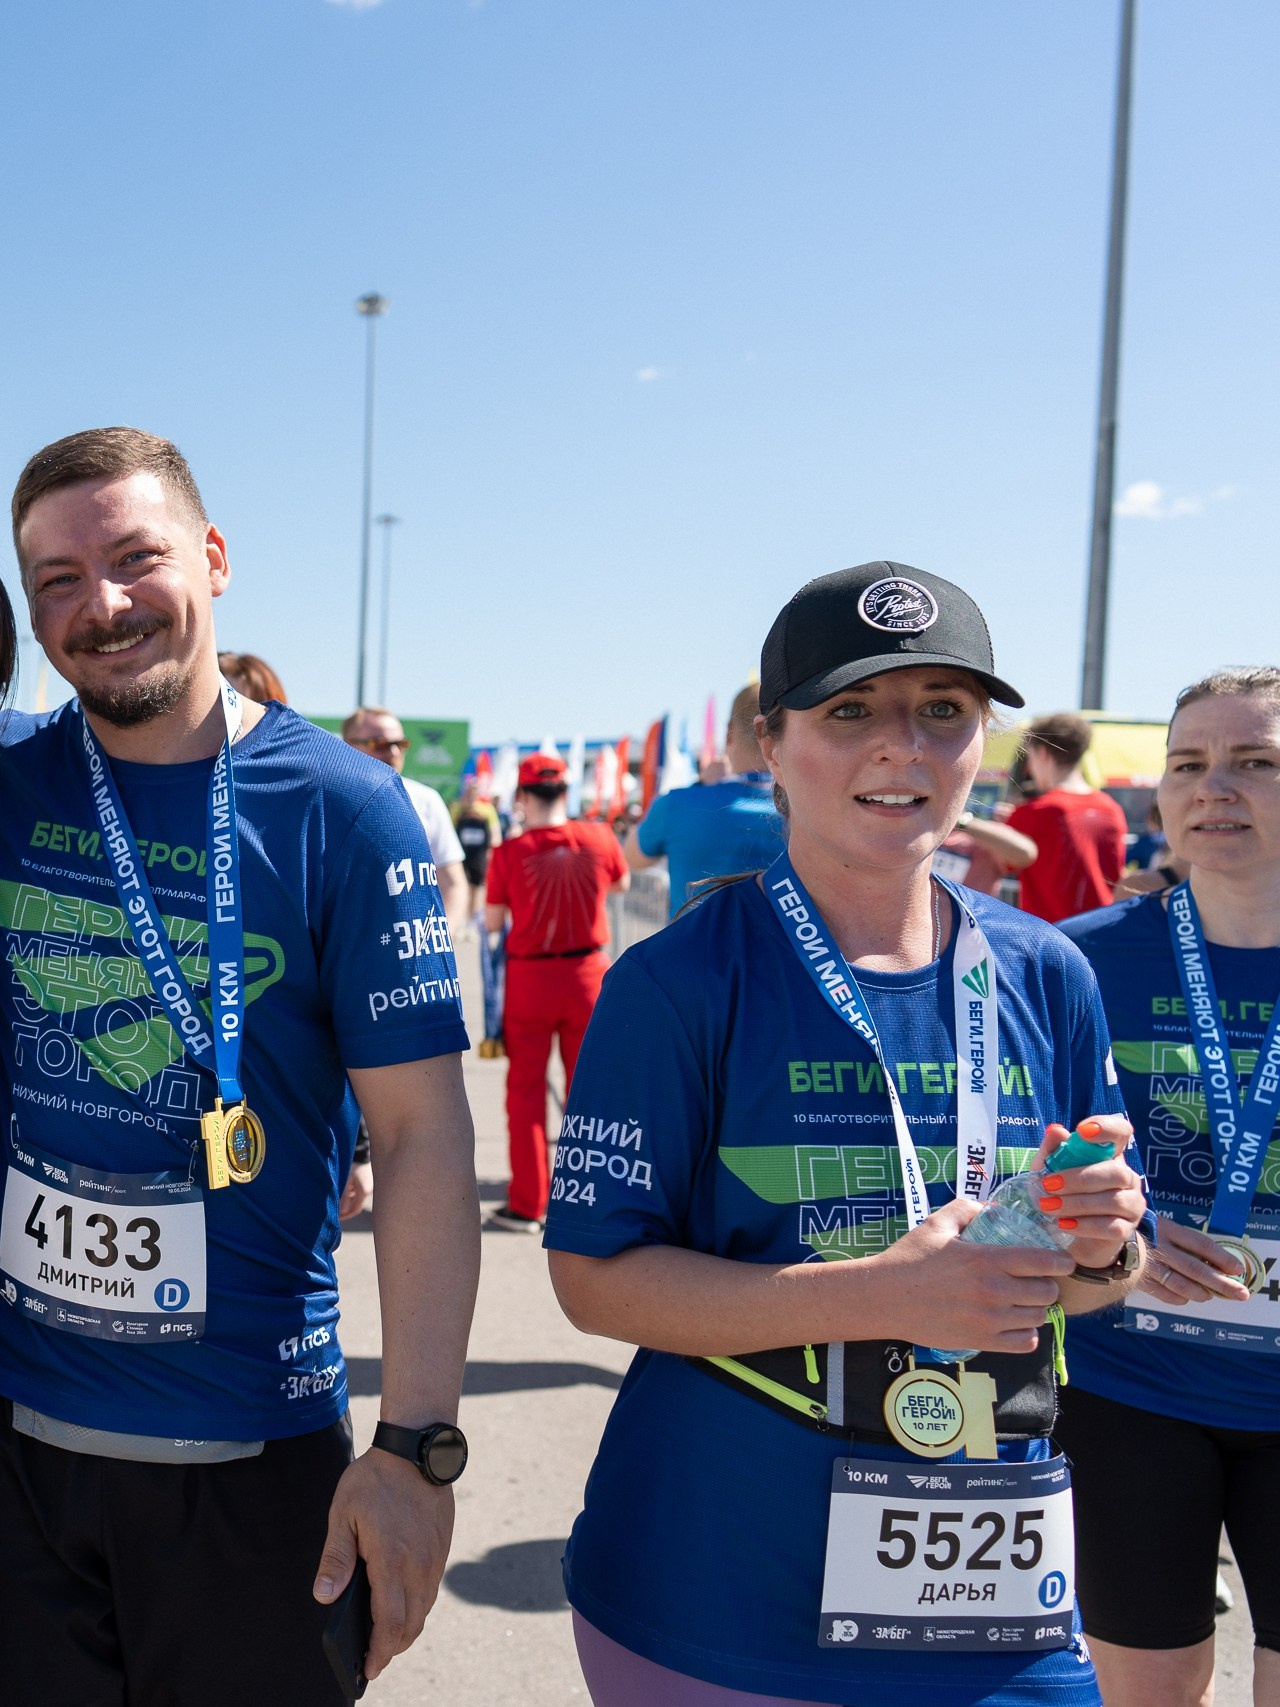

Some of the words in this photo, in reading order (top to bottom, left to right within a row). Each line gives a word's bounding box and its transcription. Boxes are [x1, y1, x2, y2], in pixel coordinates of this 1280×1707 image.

[21, 858, 31, 868] 10
[31, 863, 117, 888] БЛАГОТВОРИТЕЛЬ
[214, 833, 237, 923] ГЕРОИ
[94, 786, 141, 892] МЕНЯЮТ
[128, 895, 166, 961] ЭТОТ
[153, 965, 213, 1056] ГОРОД
[772, 878, 828, 960] ГЕРОИ
[1173, 888, 1199, 950] ГЕРОИ
[1183, 953, 1220, 1042] МЕНЯЮТ
[221, 1012, 239, 1043] 10
[969, 1001, 983, 1038] БЕГИ,
[896, 1057, 1034, 1097] ГЕРЙ!
[971, 1041, 987, 1094] ГЕРОЙ!
[1204, 1045, 1233, 1104] ЭТОТ
[12, 1083, 67, 1110] НИЖНИЙ
[71, 1101, 169, 1134] НОВГОРОД
[793, 1114, 806, 1123] 10
[809, 1113, 947, 1124] БЛАГОТВОРИТЛЬНЫЙ
[17, 1150, 24, 1161] 10
[551, 1177, 596, 1206] 2024
[1227, 1171, 1250, 1193] 10
[24, 1194, 161, 1271] 4133
[37, 1260, 135, 1299] ДМИТРИЙ
[163, 1283, 182, 1307] D
[173, 1323, 192, 1332] ПСБ
[301, 1326, 331, 1351] ПСБ
[902, 1406, 956, 1420] ГЕРОЙ!
[913, 1422, 924, 1430] 10
[926, 1423, 948, 1431] ЛЕТ
[847, 1471, 862, 1482] 10
[864, 1472, 888, 1485] КМ
[877, 1509, 1045, 1571] 5525
[918, 1583, 996, 1604] ДАРЬЯ
[1045, 1576, 1061, 1604] D
